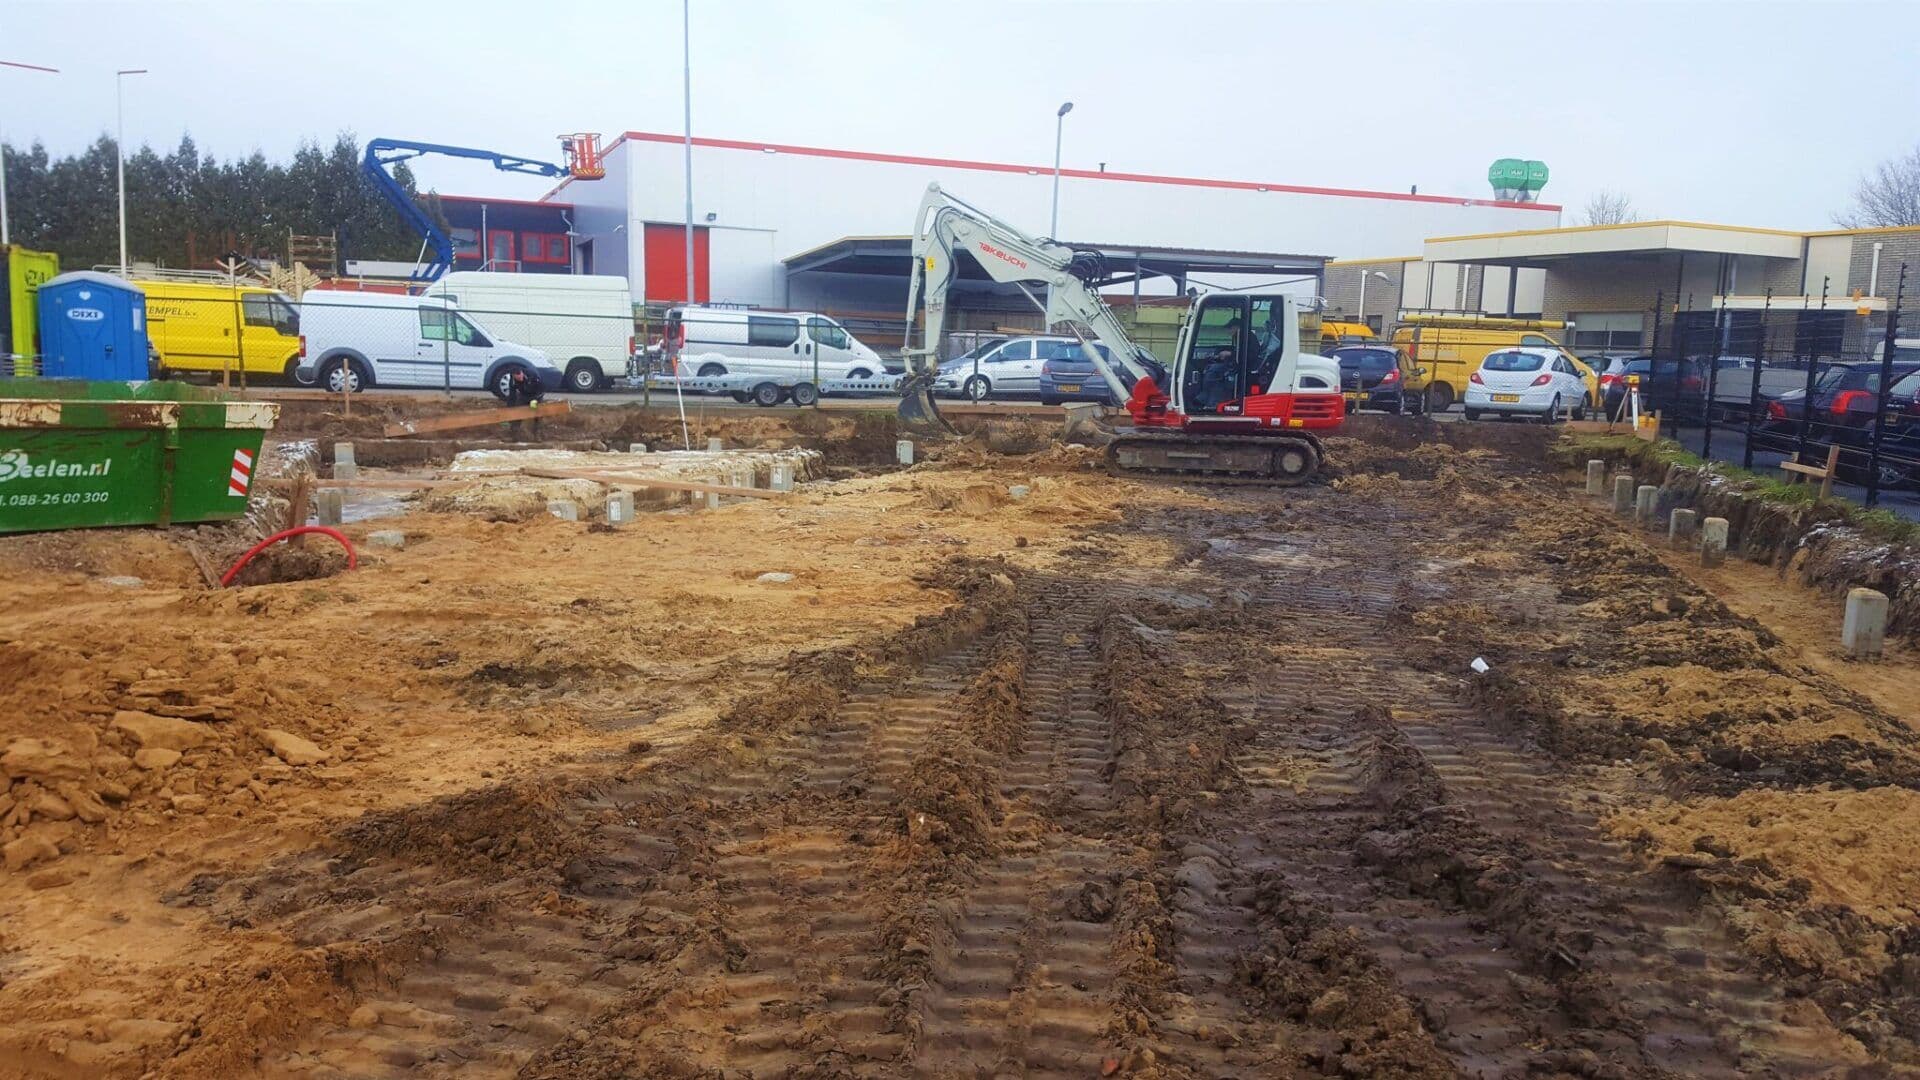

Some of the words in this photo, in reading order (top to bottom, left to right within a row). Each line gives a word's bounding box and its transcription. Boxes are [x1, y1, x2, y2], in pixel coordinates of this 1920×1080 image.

[72, 310, 99, 319] DIXI
[146, 307, 183, 316] EMPEL
[9, 493, 60, 506] 088-26
[62, 493, 81, 504] 00
[82, 492, 109, 503] 300
